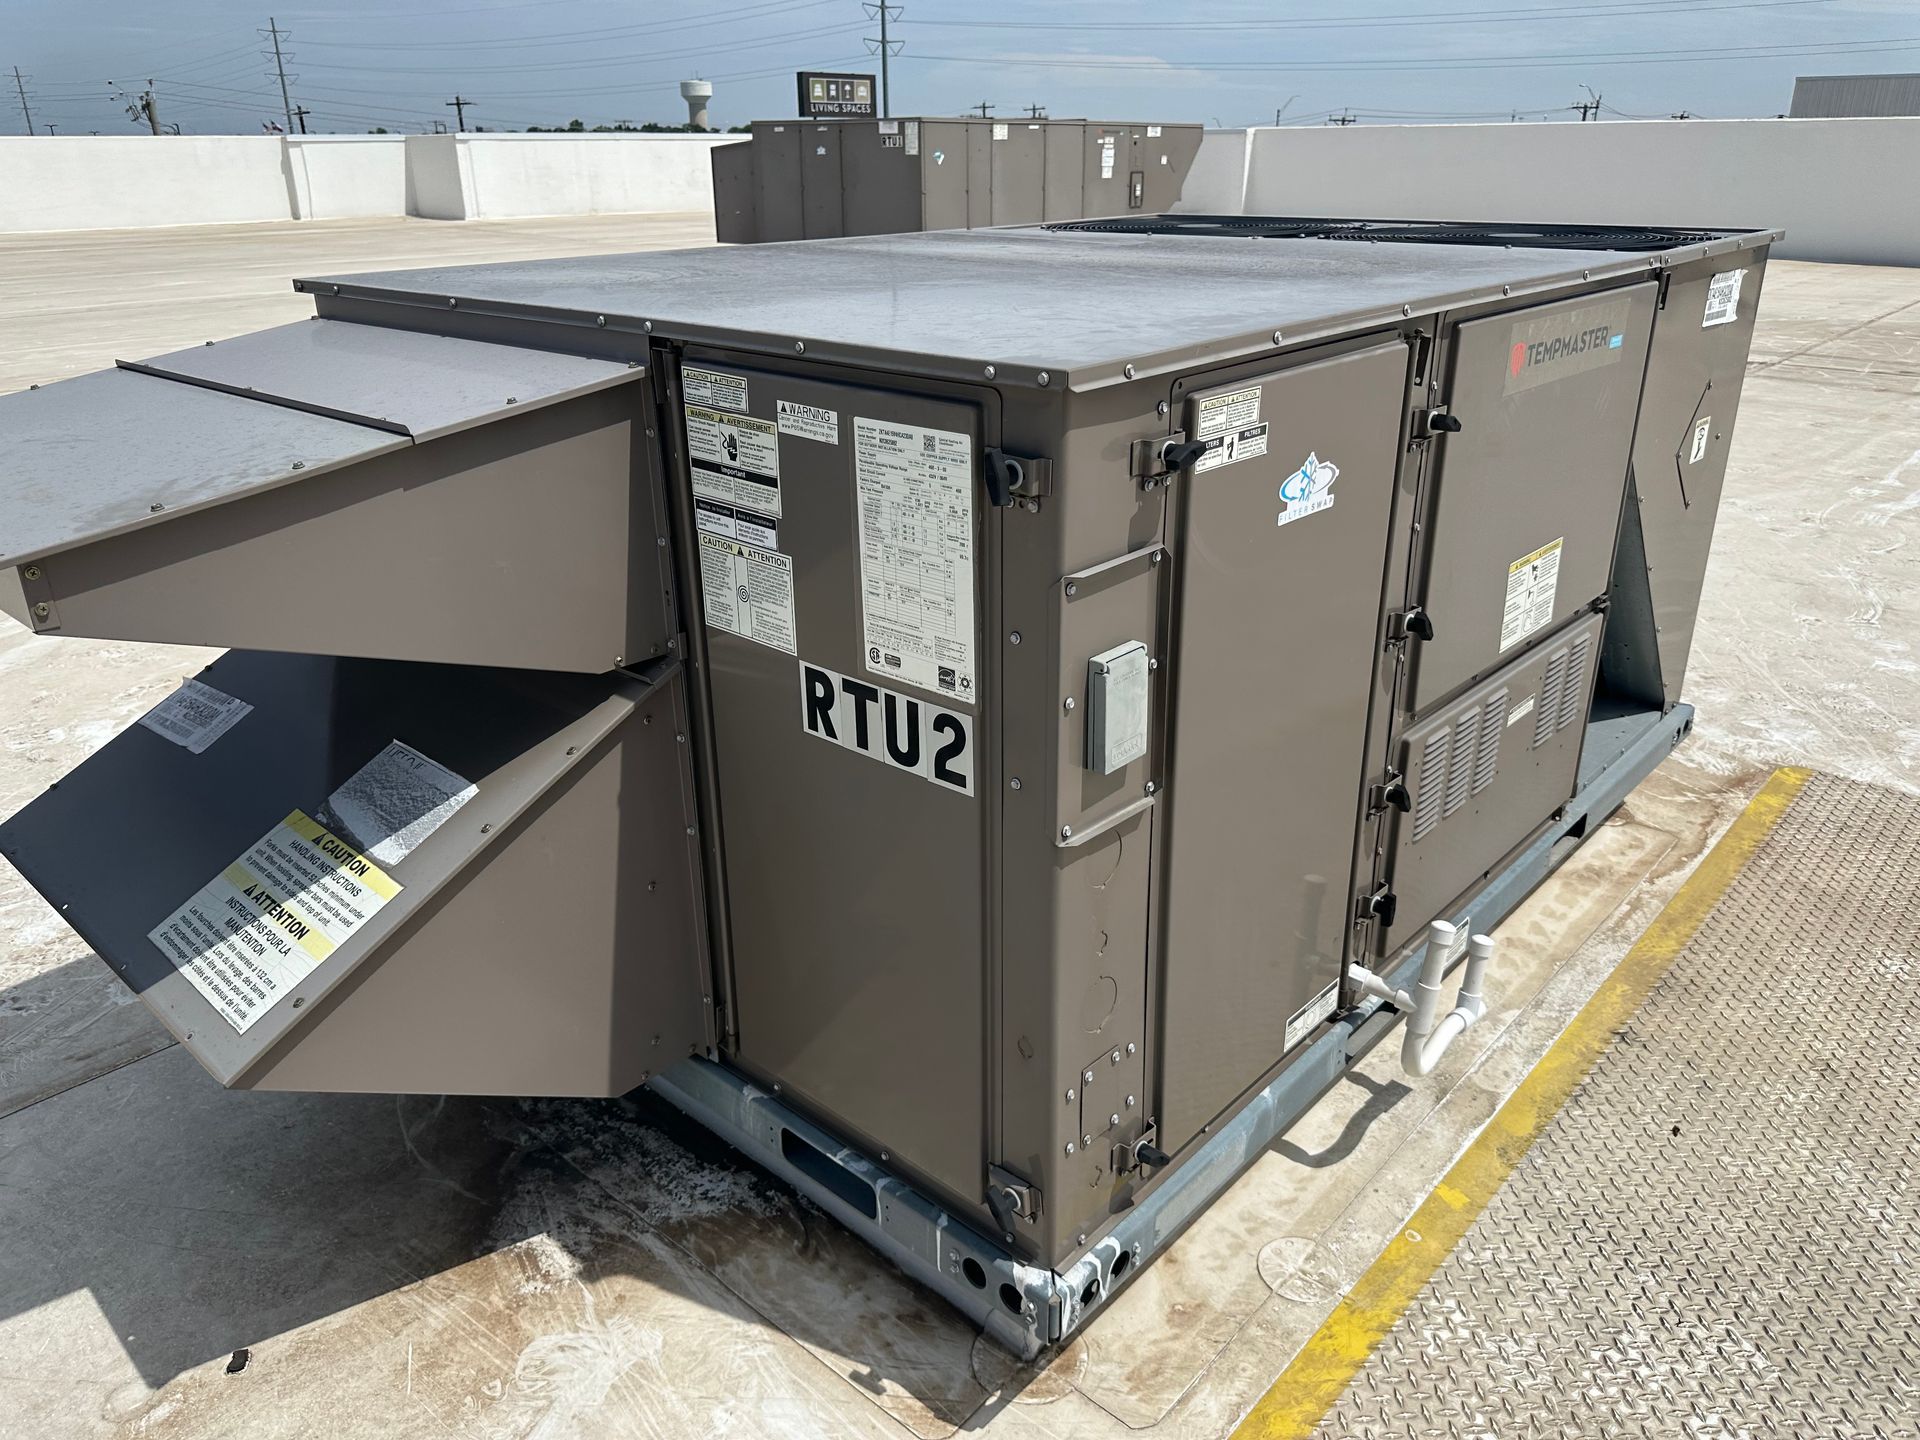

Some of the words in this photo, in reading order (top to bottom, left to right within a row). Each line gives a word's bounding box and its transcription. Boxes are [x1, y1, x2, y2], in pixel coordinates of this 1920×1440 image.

[810, 103, 839, 113] LIVING
[842, 104, 871, 114] SPACES
[1528, 326, 1608, 366] TEMPMASTER
[689, 372, 709, 380] CAUTION
[719, 378, 743, 387] ATTENTION
[1208, 398, 1226, 409] CAUTION
[1236, 391, 1257, 401] ATTENTION
[690, 409, 714, 421] WARNING
[727, 418, 771, 433] AVERTISSEMENT
[789, 403, 831, 422] WARNING
[1244, 428, 1261, 438] FILTRES
[1206, 439, 1220, 449] LTERS
[1280, 506, 1308, 523] FILTER
[1311, 497, 1333, 511] SWAP
[703, 536, 733, 552] CAUTION
[748, 550, 787, 568] ATTENTION
[804, 666, 966, 788] RTU2
[245, 854, 253, 862] to
[248, 859, 268, 874] prevent
[289, 840, 320, 865] HANDLING
[317, 861, 361, 897] INSTRUCTIONS
[323, 840, 369, 876] CAUTION
[264, 838, 278, 851] Forks
[275, 848, 289, 860] must
[285, 855, 293, 864] be
[292, 860, 312, 877] inserted
[313, 878, 330, 893] inches
[328, 890, 350, 909] minimum
[348, 906, 364, 919] under
[264, 871, 283, 887] damage
[280, 883, 287, 891] to
[264, 853, 278, 866] When
[292, 878, 313, 895] spreader
[310, 892, 323, 904] bars
[321, 901, 335, 913] must
[332, 909, 341, 918] be
[338, 915, 354, 927] used
[285, 888, 299, 900] sides
[296, 897, 309, 907] and
[304, 903, 315, 914] top
[252, 891, 309, 939] ATTENTION
[317, 915, 331, 926] unit.
[226, 897, 267, 934] INSTRUCTIONS
[262, 929, 283, 948] POUR
[278, 943, 291, 957] LA
[226, 917, 266, 956] MANUTENTION
[189, 905, 199, 916] Les
[196, 912, 215, 931] fourches
[212, 928, 231, 945] doivent
[255, 968, 267, 980] 132
[262, 977, 273, 987] cm
[179, 915, 193, 928] moins
[190, 926, 202, 937] sous
[212, 946, 224, 959] Lors
[222, 956, 230, 965] du
[227, 961, 243, 980] levage,
[242, 976, 252, 986] des
[249, 983, 266, 999] barres
[159, 931, 189, 960] d'endommager
[185, 957, 194, 966] les
[206, 978, 214, 986] le
[211, 984, 228, 1001] dessus
[225, 998, 234, 1007] de
[192, 946, 210, 963] doivent
[228, 984, 244, 996] pour
